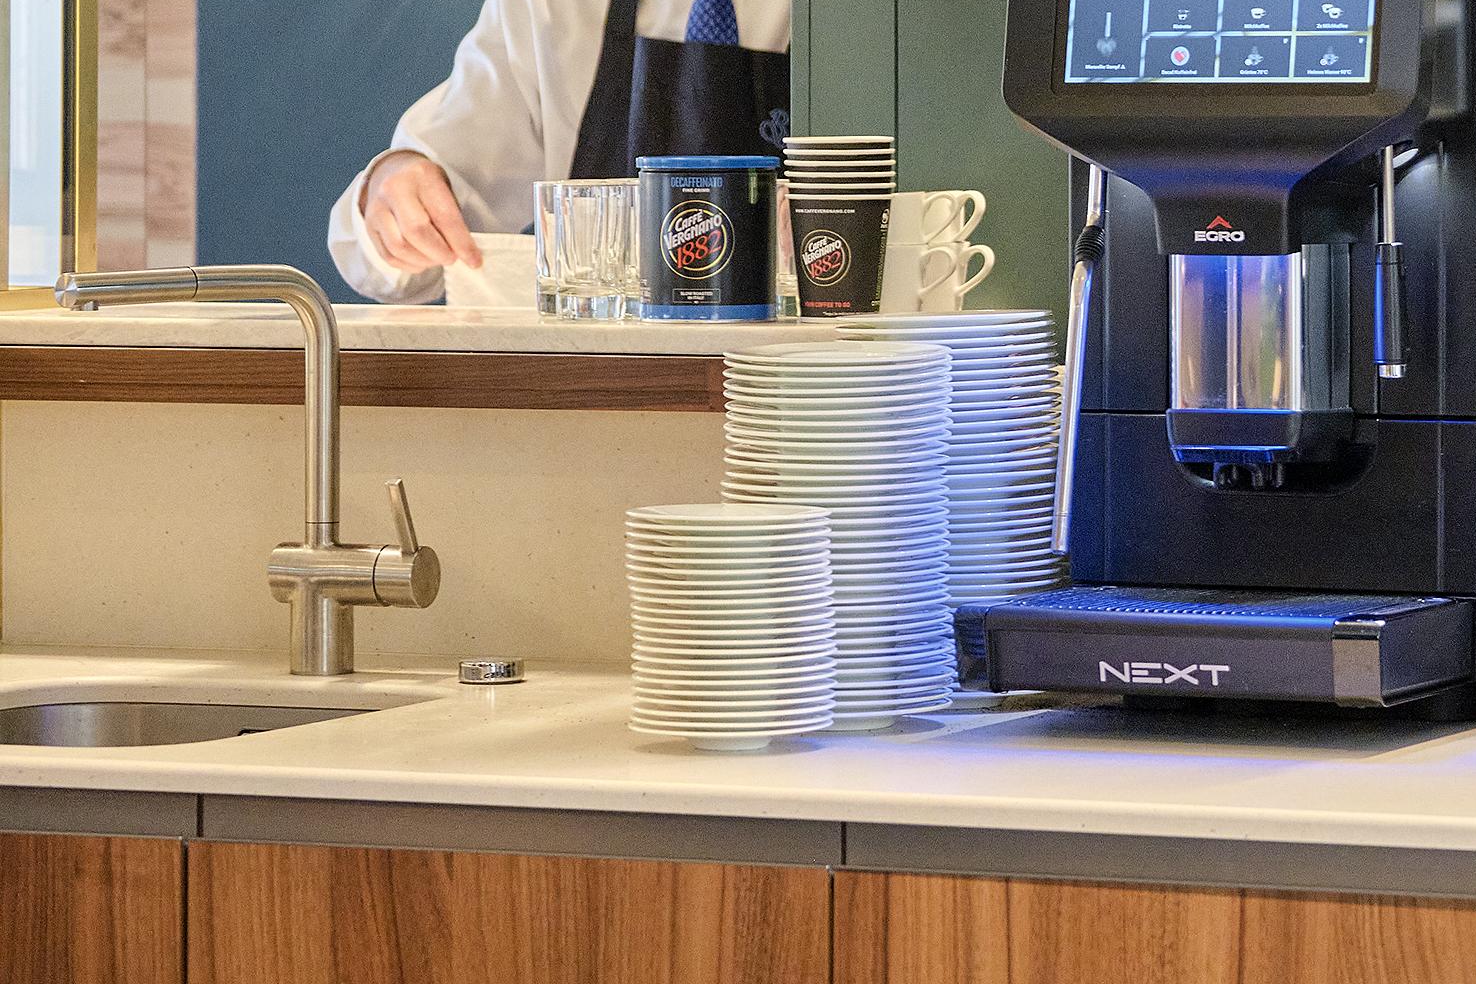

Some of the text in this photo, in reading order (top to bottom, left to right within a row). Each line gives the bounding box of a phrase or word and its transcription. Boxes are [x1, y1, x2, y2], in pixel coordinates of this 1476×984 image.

[671, 176, 723, 187] DECAFFEINATO
[663, 214, 723, 250] VERGNANO
[1194, 231, 1246, 242] EGRO
[677, 229, 722, 269] 1882
[801, 239, 842, 266] VERGNANO
[810, 250, 842, 279] 1882
[1099, 661, 1230, 687] NEXT
